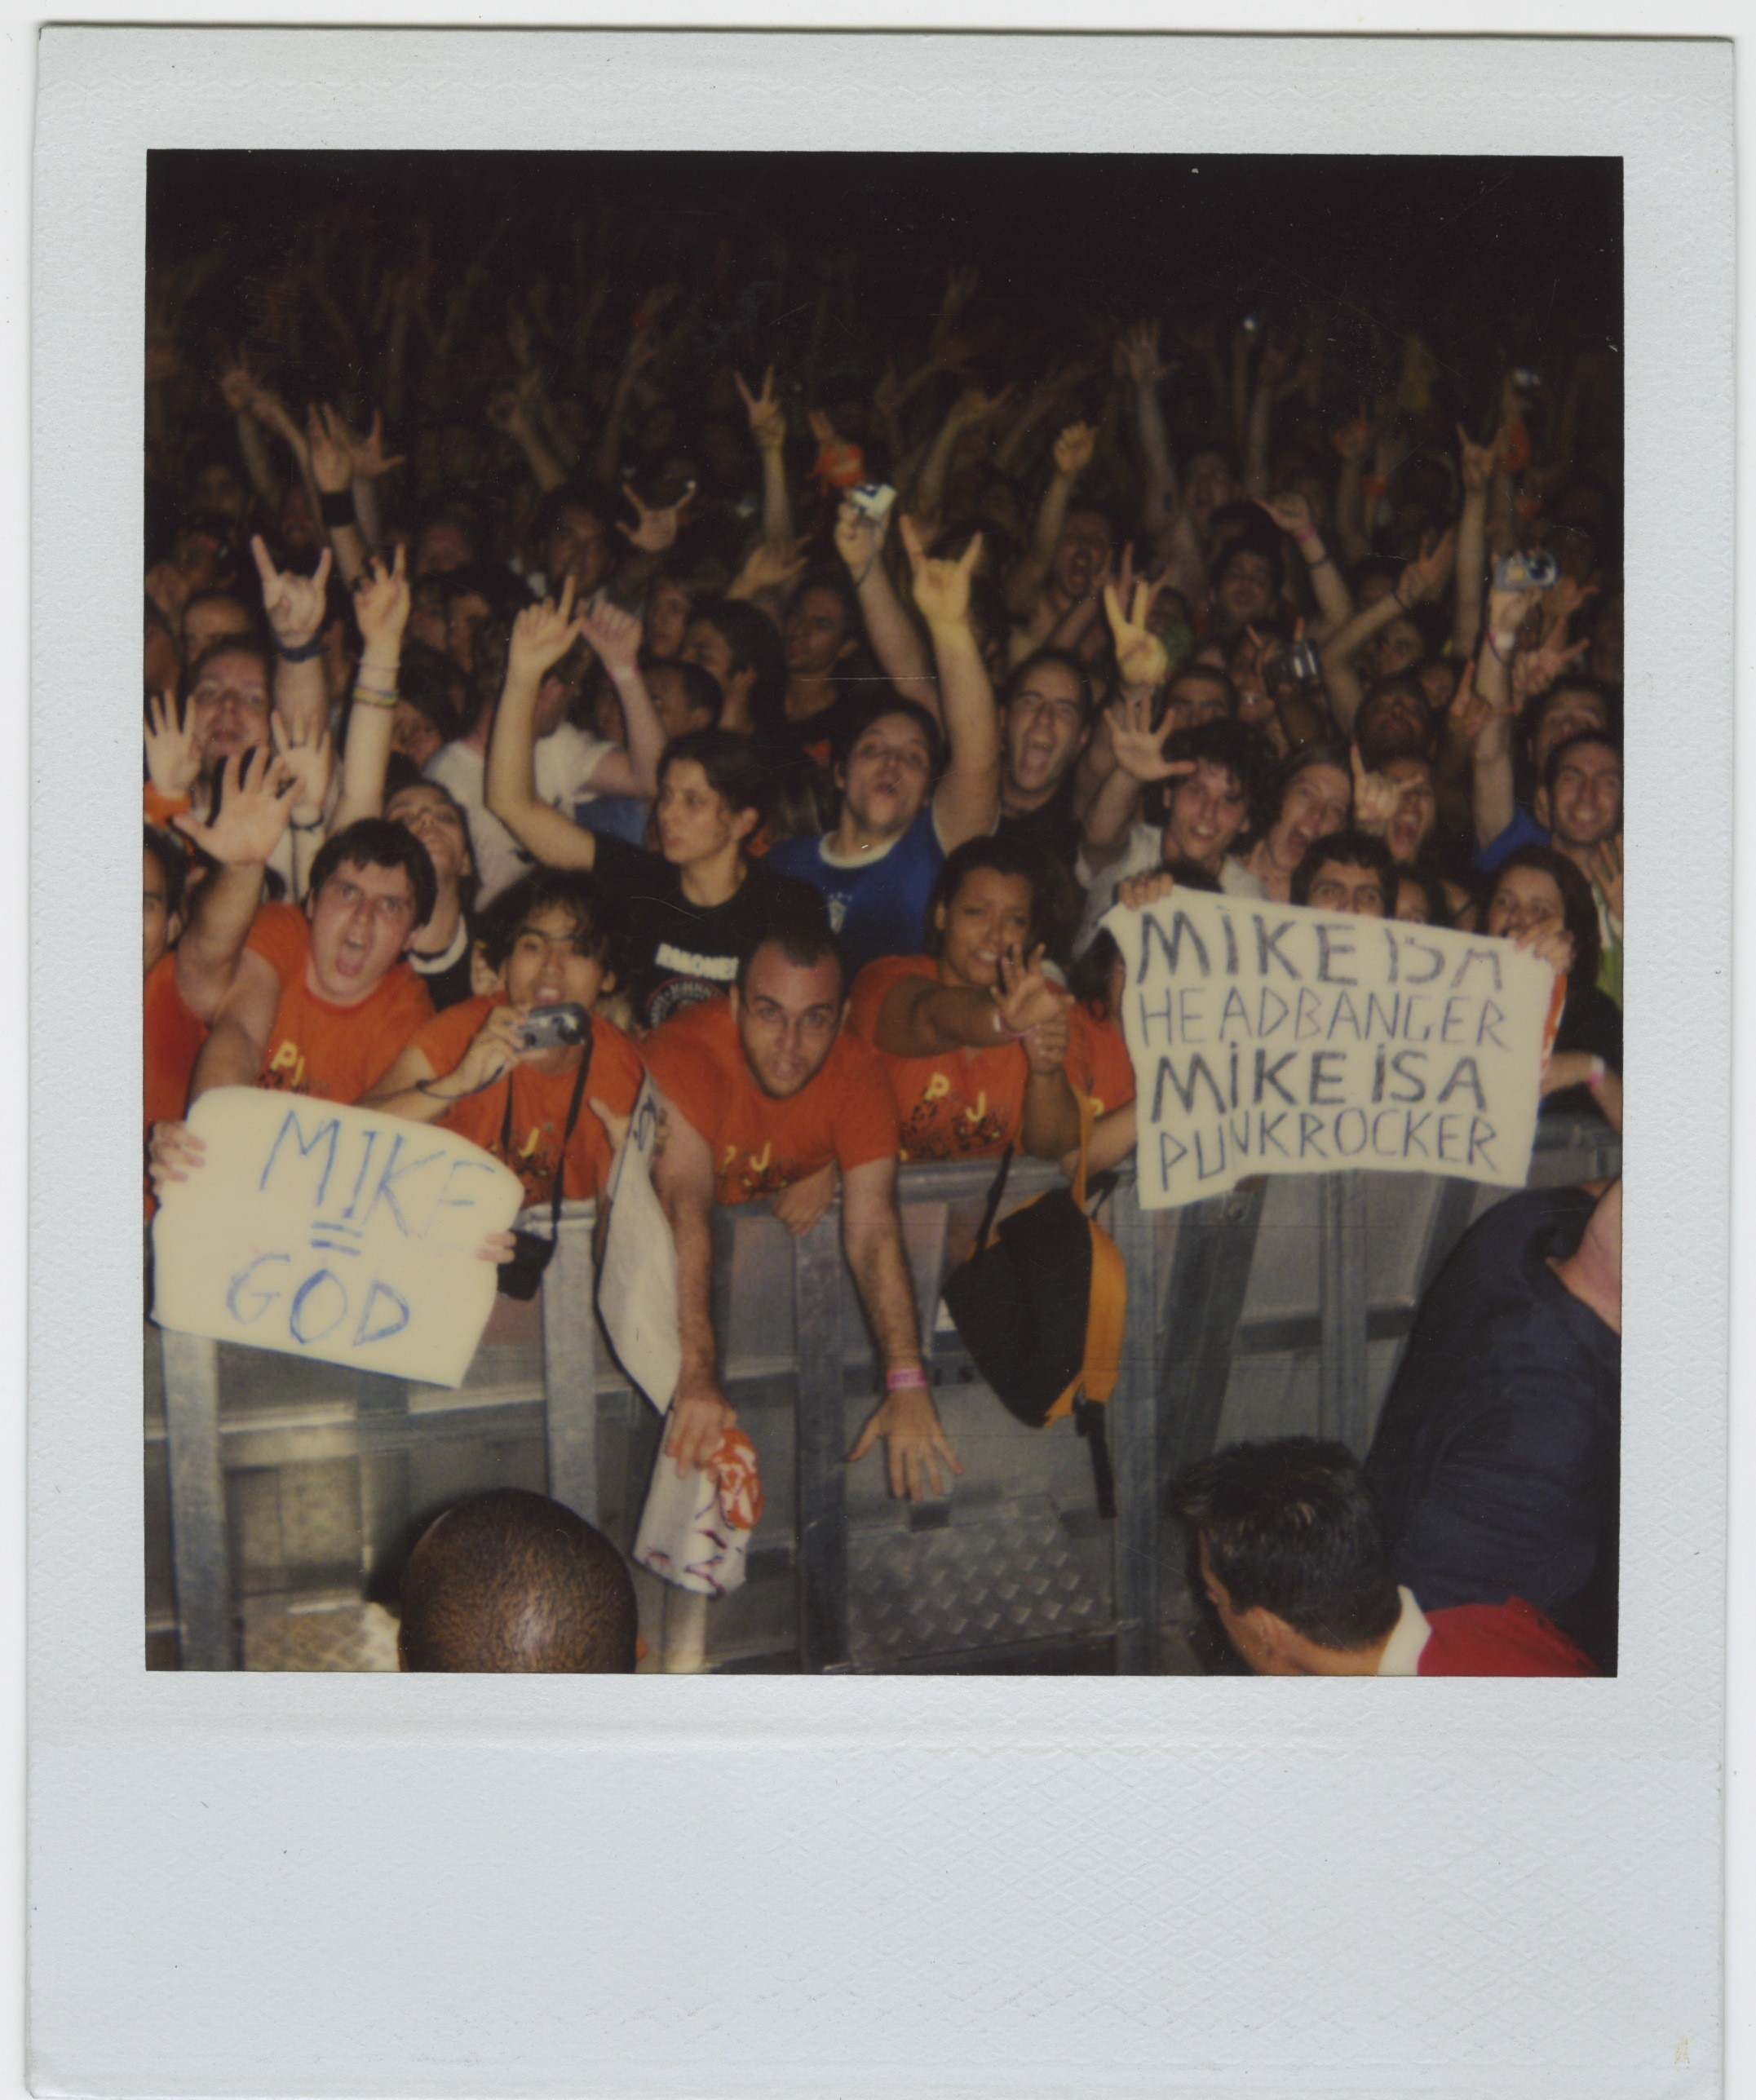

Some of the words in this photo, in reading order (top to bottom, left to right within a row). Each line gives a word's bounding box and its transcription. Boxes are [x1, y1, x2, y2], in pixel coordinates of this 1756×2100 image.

[1138, 985, 1511, 1052] HEADBANGER
[258, 1108, 497, 1246] MIKE
[226, 1251, 411, 1347] GOD
